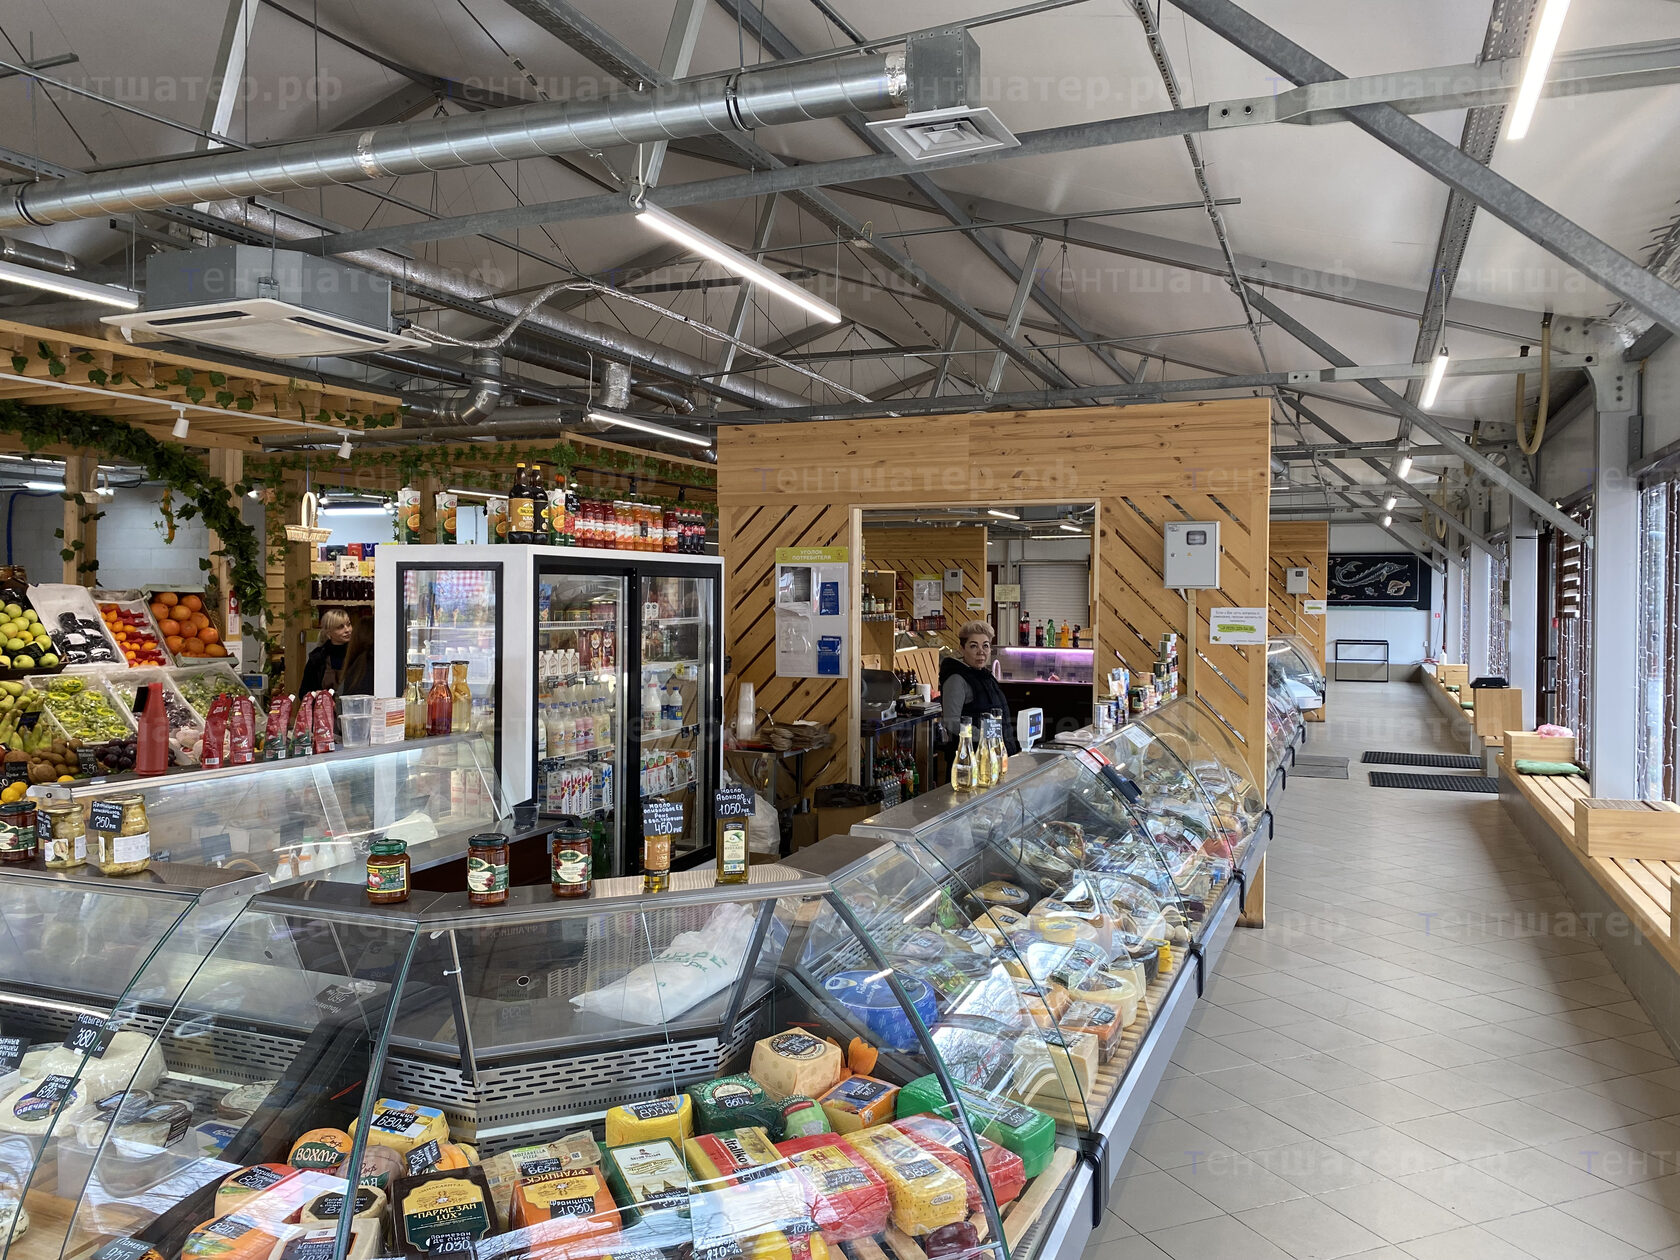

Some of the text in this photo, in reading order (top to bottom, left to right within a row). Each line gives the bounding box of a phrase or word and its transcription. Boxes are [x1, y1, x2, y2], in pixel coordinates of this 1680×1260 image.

[654, 821, 673, 835] 450
[73, 1027, 97, 1048] 380
[376, 1115, 403, 1128] 680
[724, 1138, 748, 1163] Italiko
[526, 1167, 589, 1185] ФРАНЦИСК
